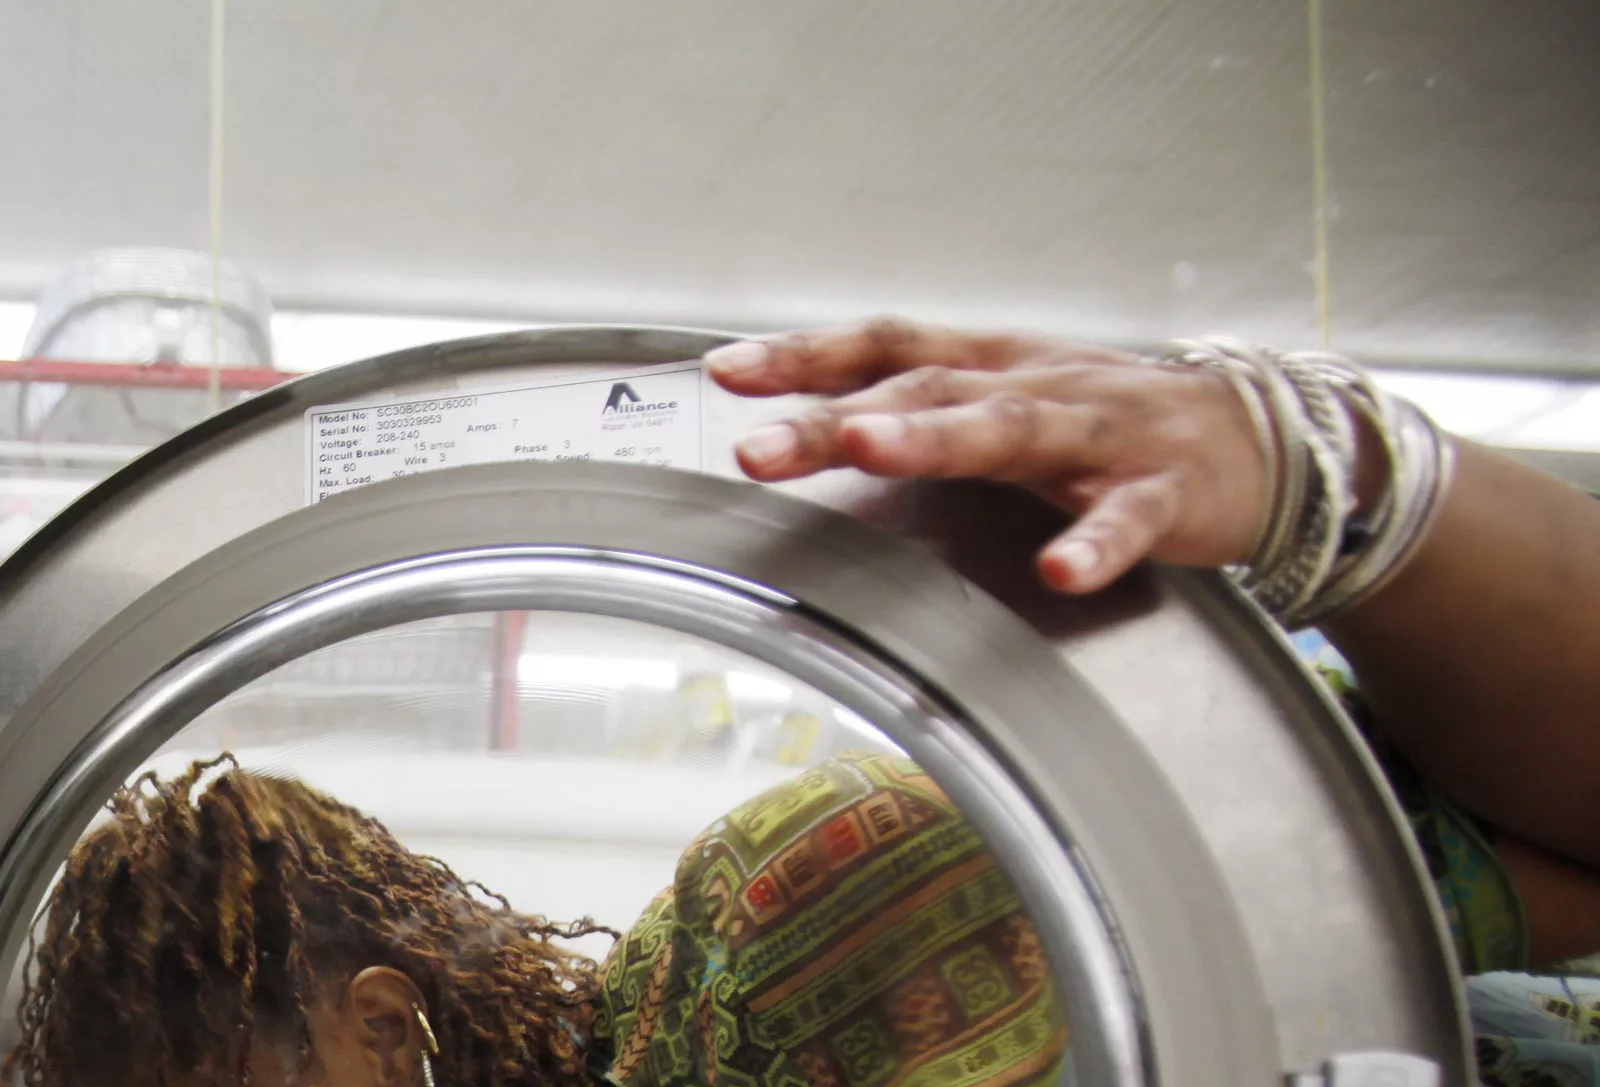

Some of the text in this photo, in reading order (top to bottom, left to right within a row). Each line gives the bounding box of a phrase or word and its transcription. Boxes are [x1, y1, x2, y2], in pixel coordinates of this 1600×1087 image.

[319, 412, 349, 424] Model
[352, 411, 370, 421] No:
[320, 424, 349, 437] Serial
[352, 423, 370, 433] No:
[320, 437, 362, 450] Voltage:
[376, 429, 421, 443] 208-240
[466, 422, 502, 433] Amps:
[319, 450, 353, 462] Circuit
[356, 446, 400, 458] Breaker:
[414, 441, 427, 451] 15
[319, 438, 572, 476] Hz 60 Wire 3 Phase 3
[319, 480, 343, 489] Max.
[346, 474, 375, 486] Load:
[614, 446, 636, 457] 480
